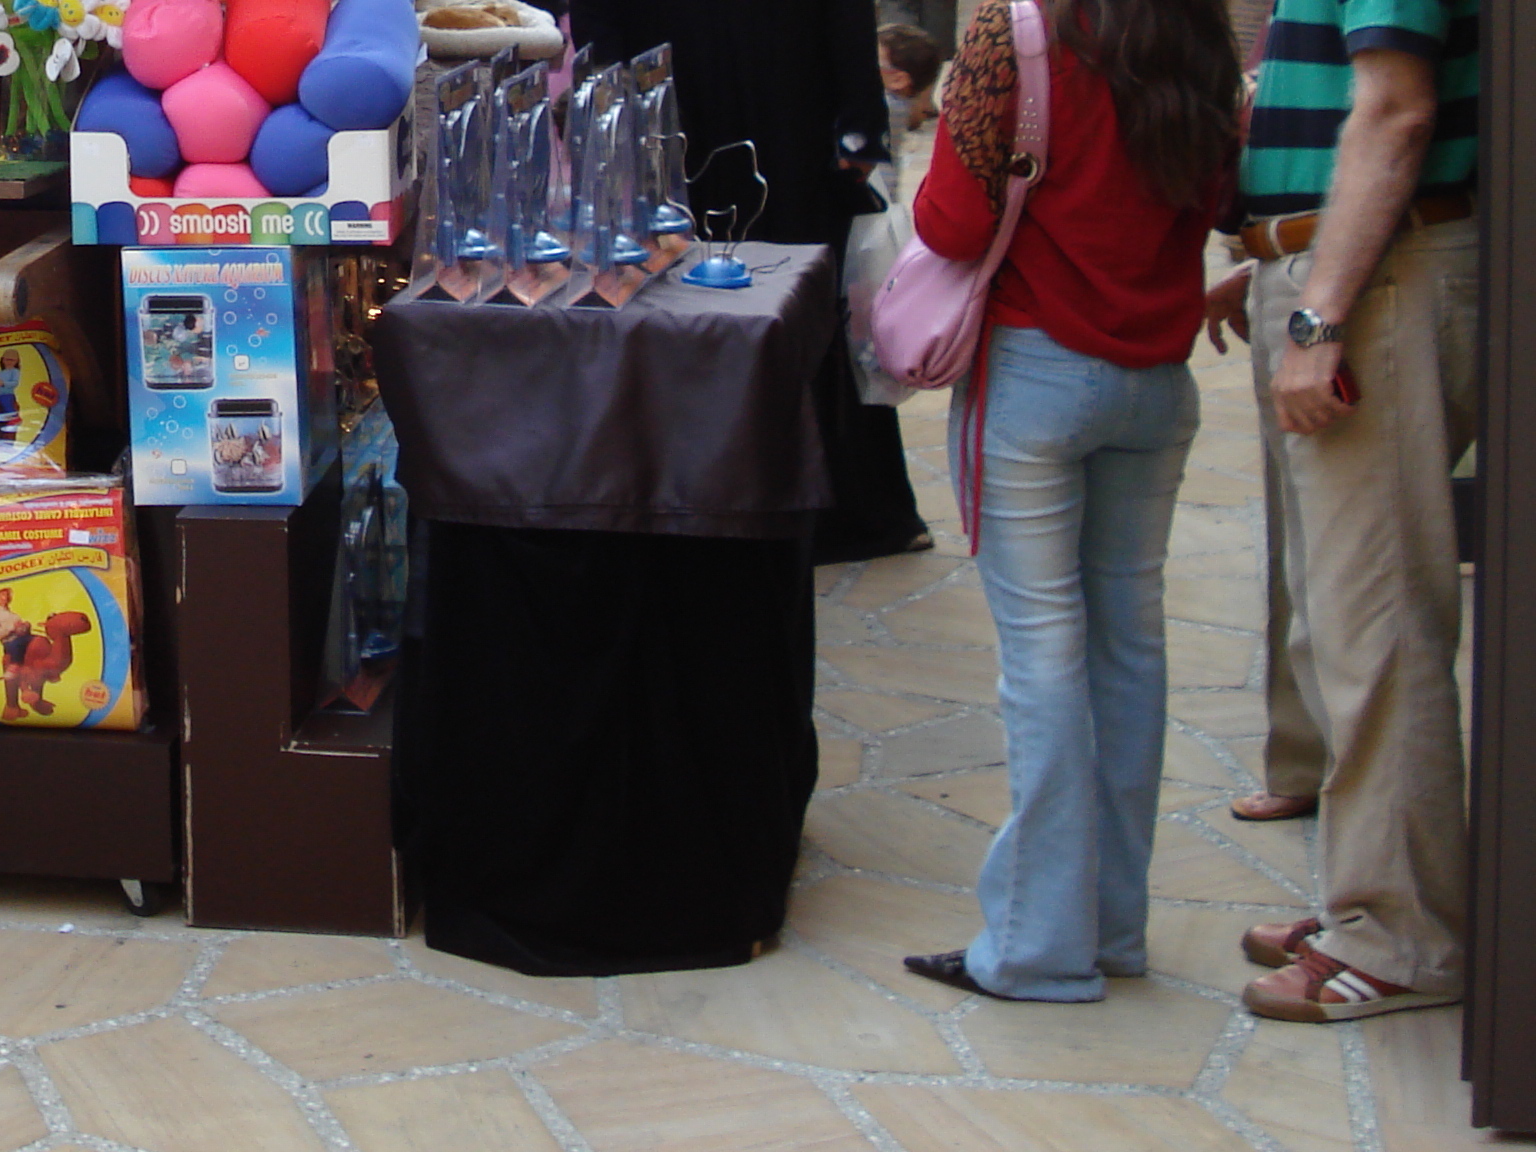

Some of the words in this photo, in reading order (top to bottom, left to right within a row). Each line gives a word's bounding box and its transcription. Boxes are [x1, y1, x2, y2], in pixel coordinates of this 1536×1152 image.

[169, 210, 252, 235] smoosh
[262, 213, 295, 234] me
[129, 265, 171, 285] DISCUS
[221, 262, 284, 289] AQUARIUM
[23, 528, 64, 539] COSTUME
